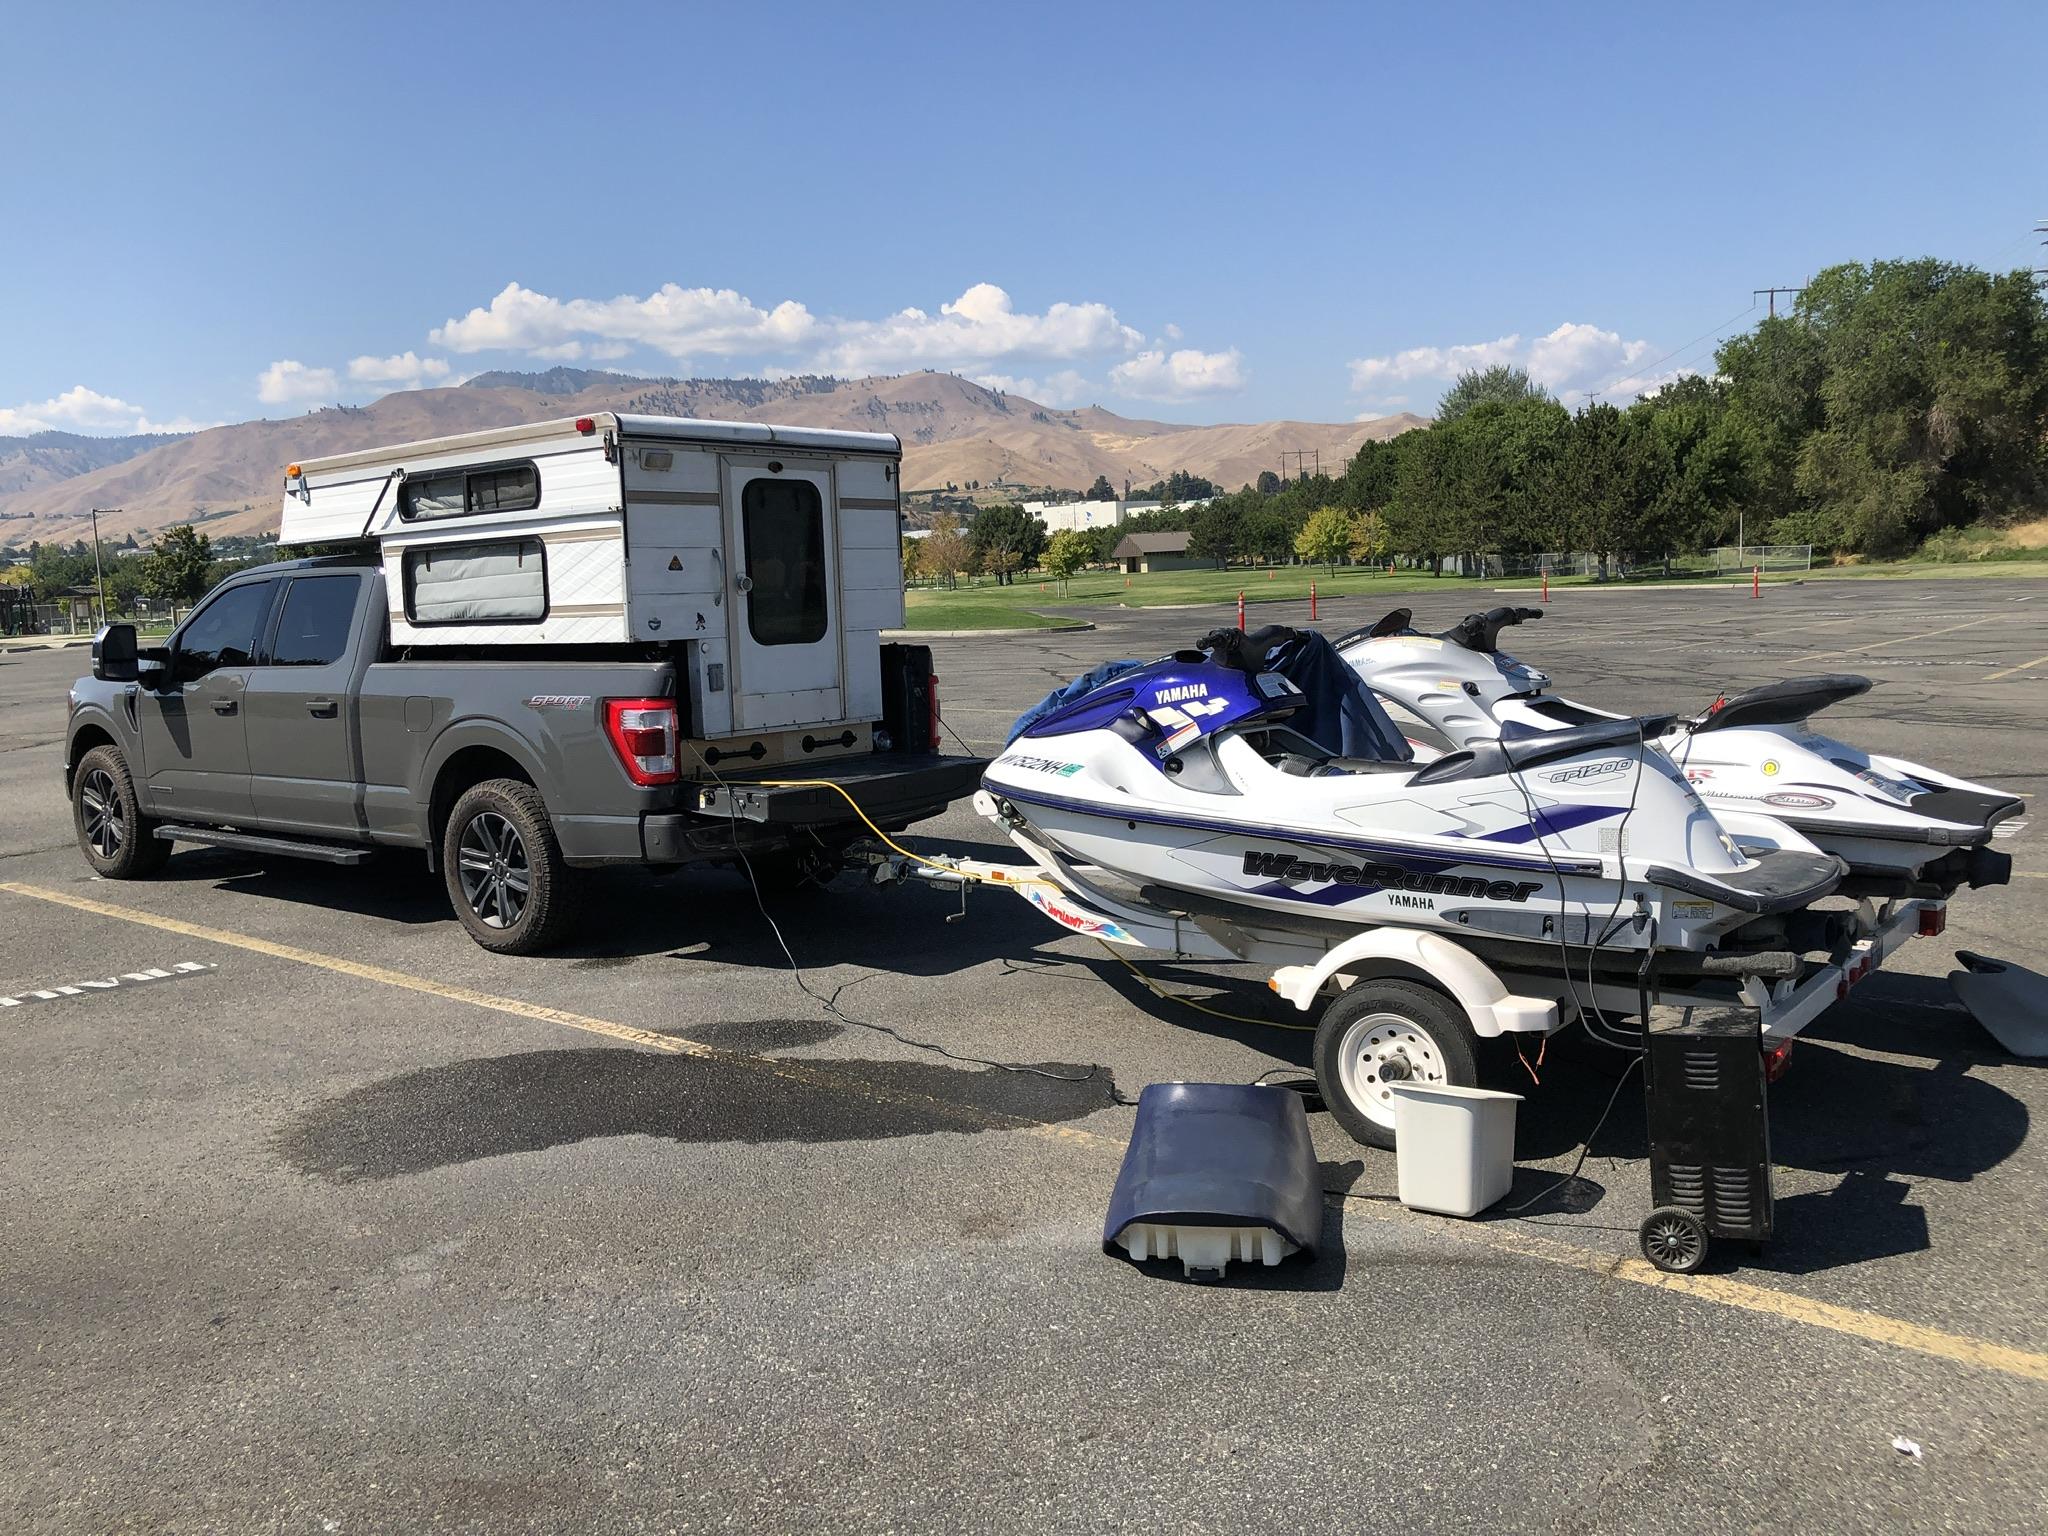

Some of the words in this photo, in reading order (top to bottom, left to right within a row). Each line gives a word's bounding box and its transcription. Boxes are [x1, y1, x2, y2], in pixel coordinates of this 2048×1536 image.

[528, 695, 591, 708] SPORT
[1155, 683, 1208, 705] YAMAHA
[1550, 758, 1634, 783] GP1200
[1242, 851, 1543, 902] WaveRunner
[1387, 894, 1435, 910] YAMAHA
